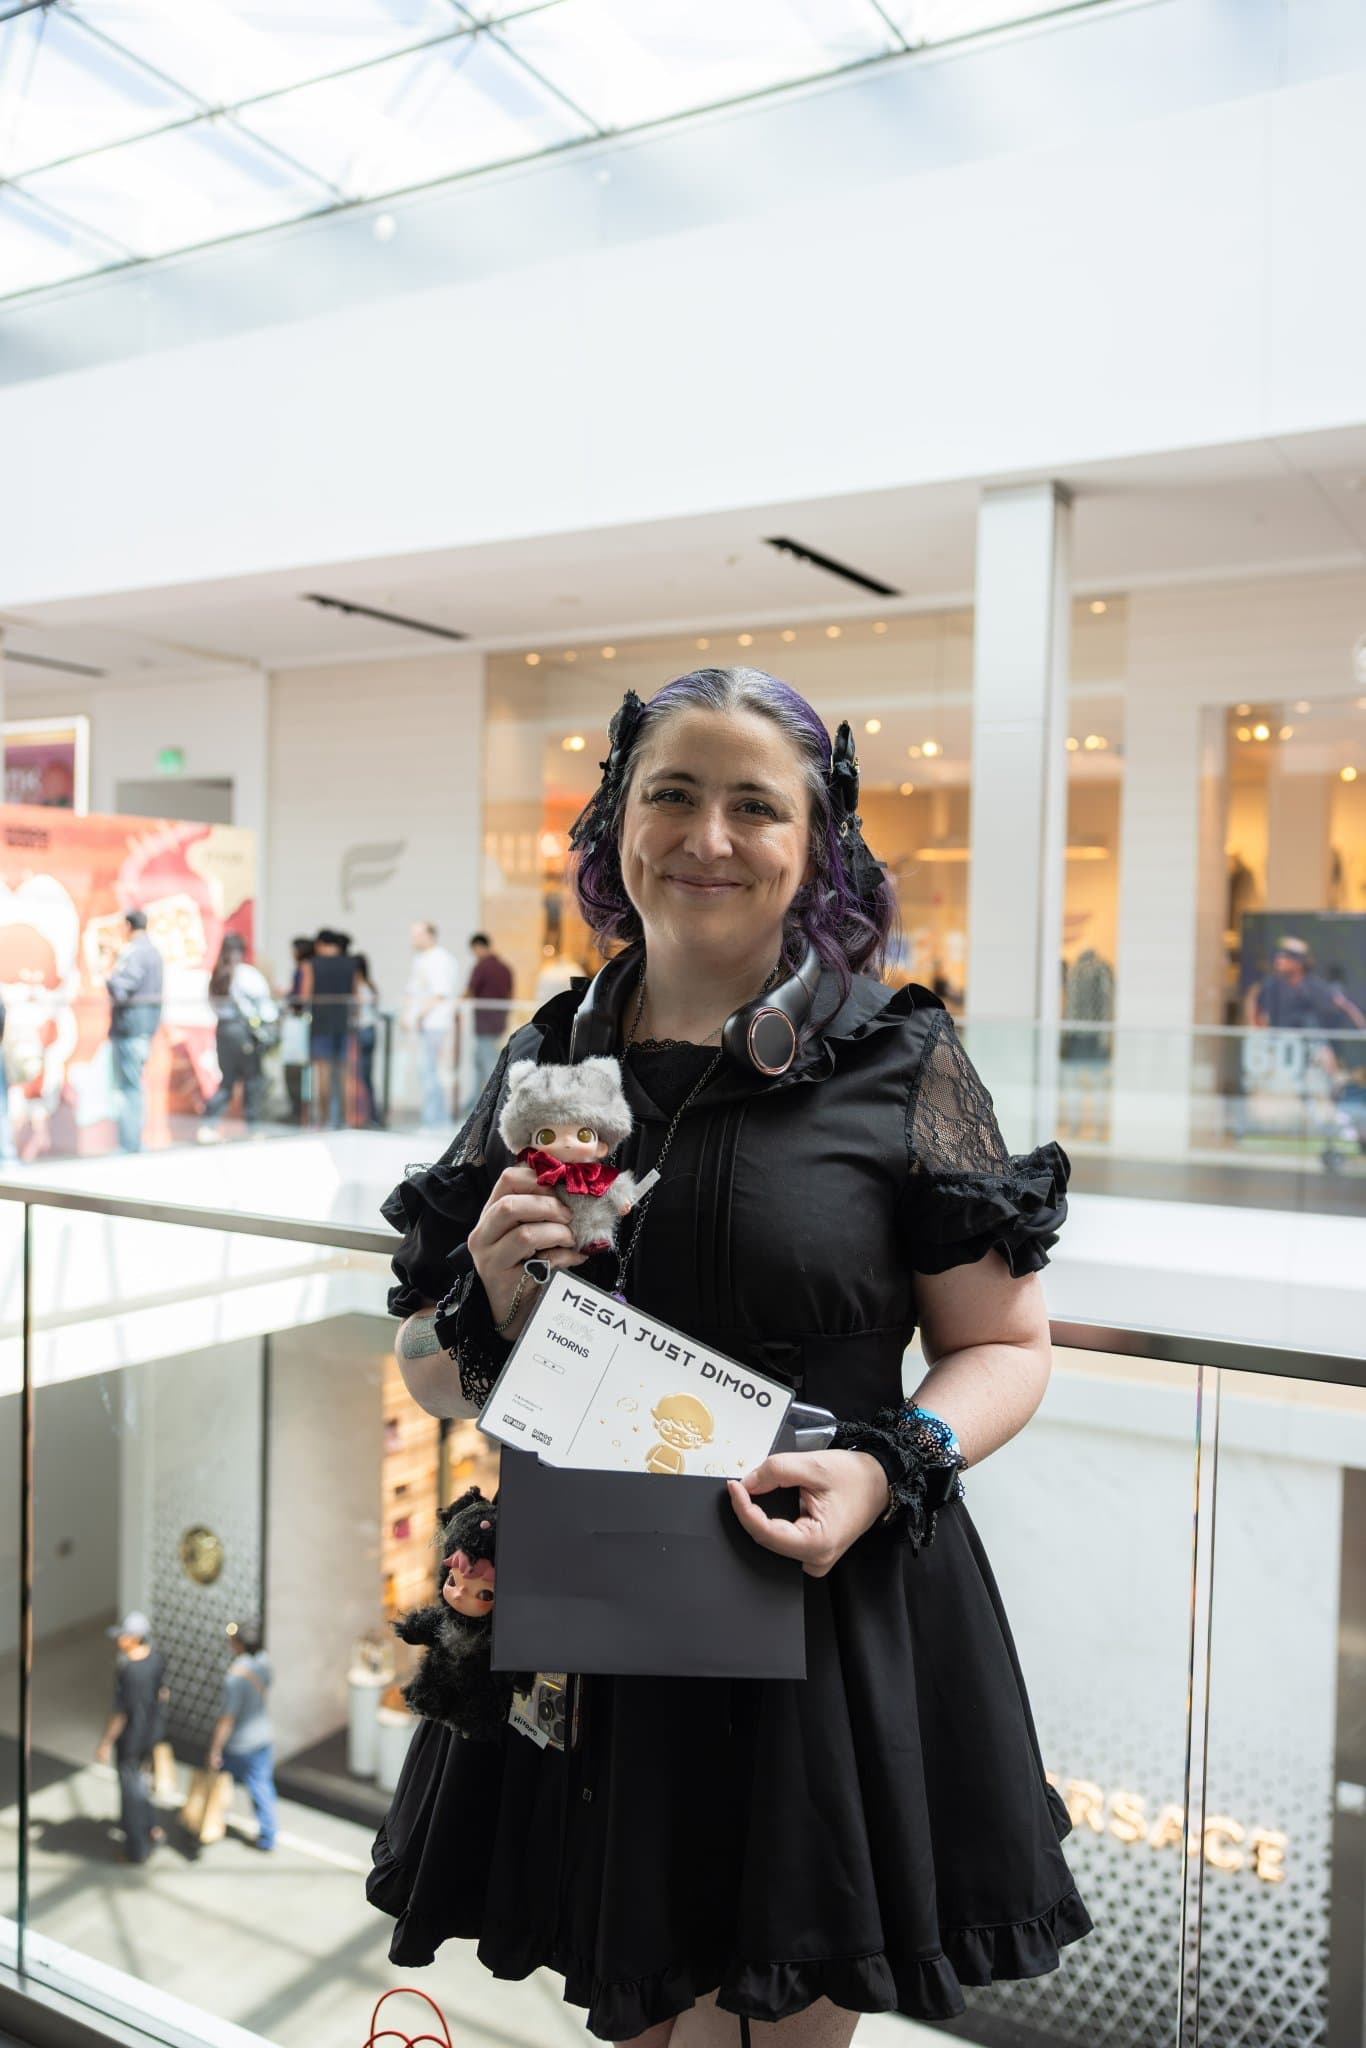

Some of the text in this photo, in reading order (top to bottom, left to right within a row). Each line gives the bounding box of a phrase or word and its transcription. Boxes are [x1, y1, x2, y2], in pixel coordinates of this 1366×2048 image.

[546, 1328, 590, 1358] THORNS
[562, 1288, 627, 1335] MEGA
[634, 1327, 696, 1366] JUST
[700, 1362, 772, 1408] DIMOO
[1046, 1771, 1288, 1882] RSACE
